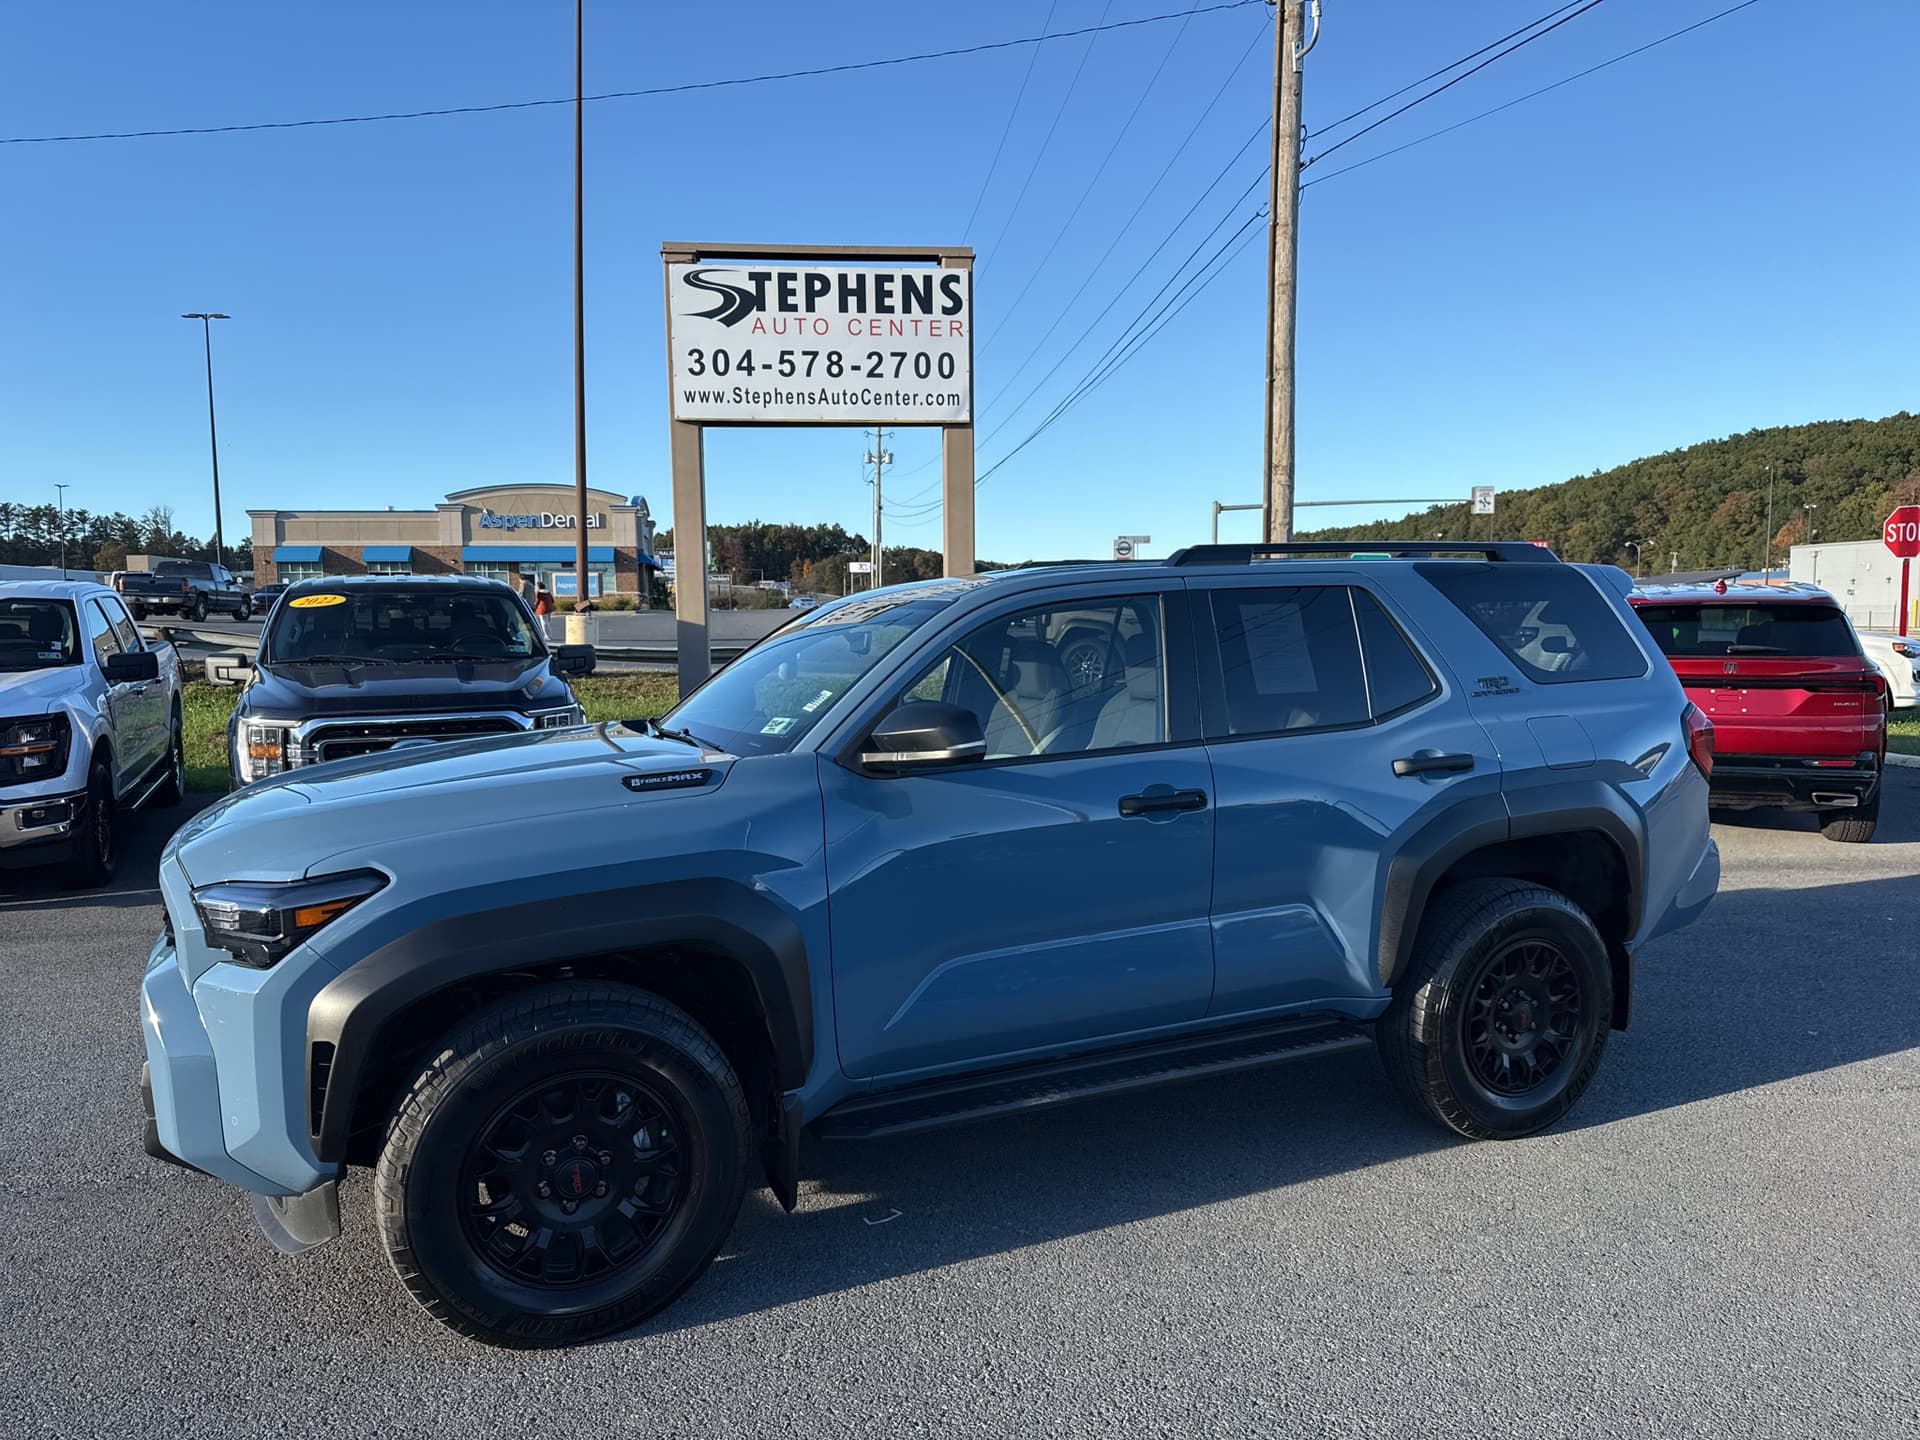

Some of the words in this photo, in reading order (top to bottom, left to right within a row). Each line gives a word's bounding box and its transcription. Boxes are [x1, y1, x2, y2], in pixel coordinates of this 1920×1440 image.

[680, 269, 963, 328] STEPHENS
[751, 317, 830, 335] AUTO
[847, 317, 964, 338] CENTER
[687, 349, 955, 379] 304-578-2700
[684, 386, 961, 409] www.StephensAutoCenter.com
[479, 508, 600, 531] AspenDenal
